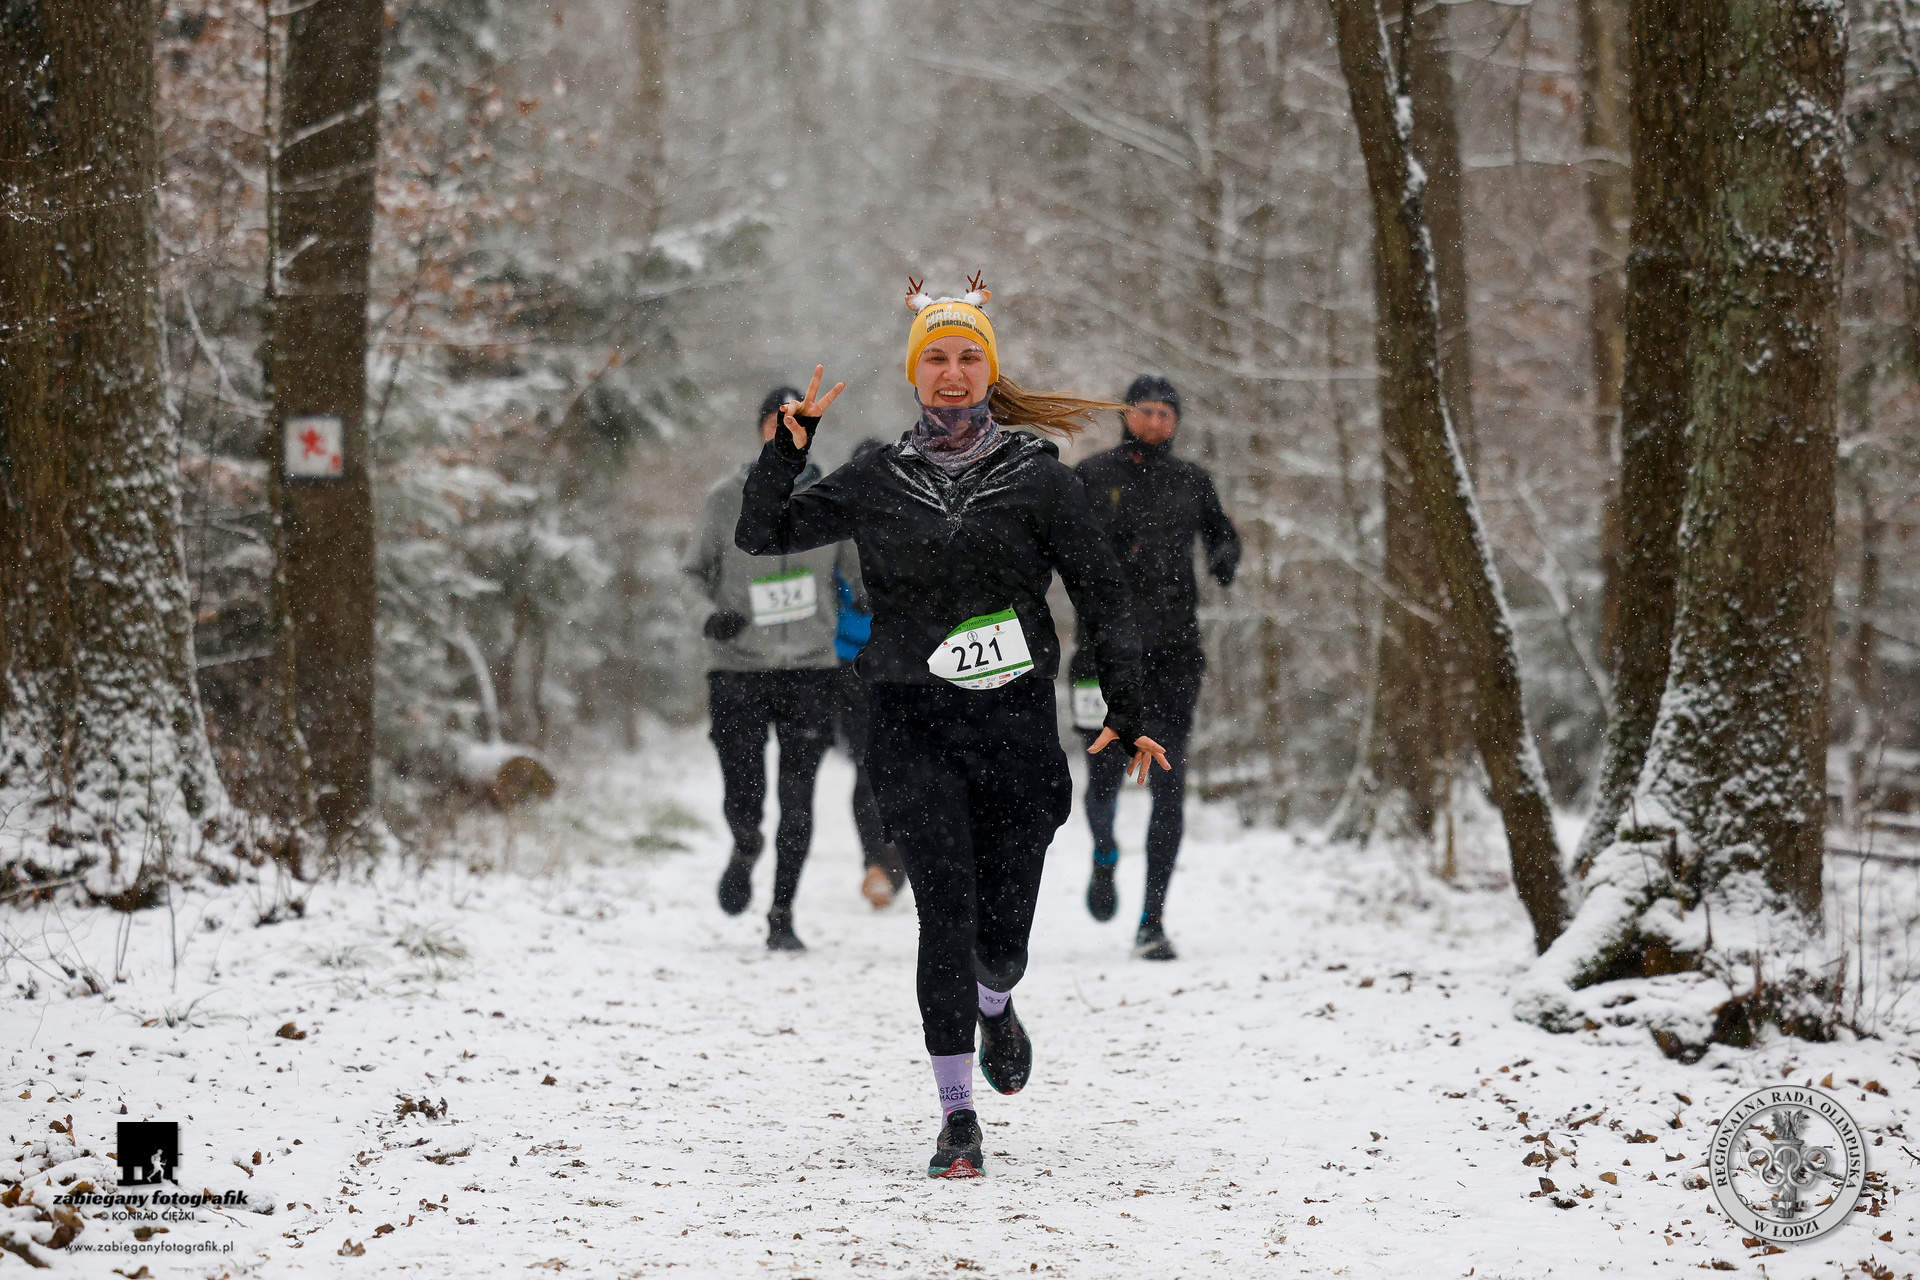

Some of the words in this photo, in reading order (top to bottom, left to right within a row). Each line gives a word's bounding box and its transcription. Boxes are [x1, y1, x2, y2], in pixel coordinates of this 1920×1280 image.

[942, 320, 972, 328] BARCELONA
[951, 637, 1003, 672] 221
[940, 1084, 965, 1095] STAY
